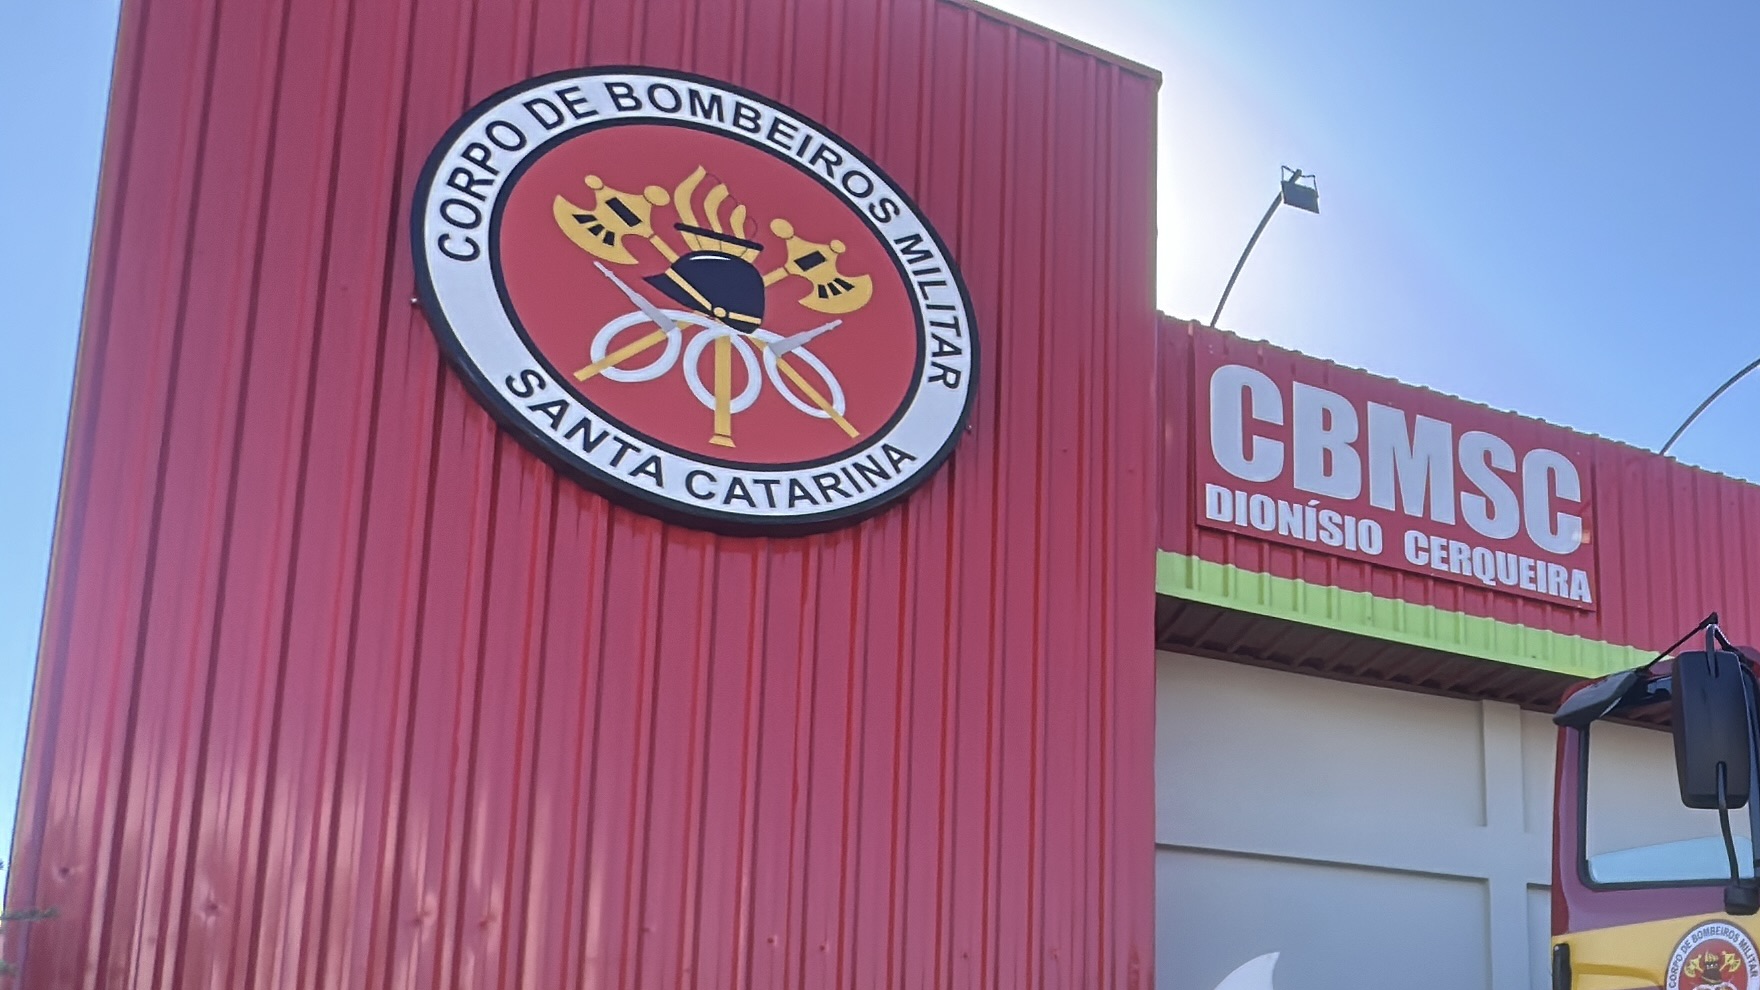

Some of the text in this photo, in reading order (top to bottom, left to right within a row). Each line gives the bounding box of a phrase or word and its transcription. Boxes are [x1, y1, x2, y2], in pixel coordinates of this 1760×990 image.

[437, 80, 965, 391] CORPO DE BOMBEIROS MILITAR
[504, 367, 918, 510] SANTA CATARINA
[1209, 364, 1582, 555] CBMSC
[1205, 482, 1593, 604] DIONÍSIO CERQUEIRA
[1668, 926, 1759, 989] CORPO DE BOMBEIROS MILITAR
